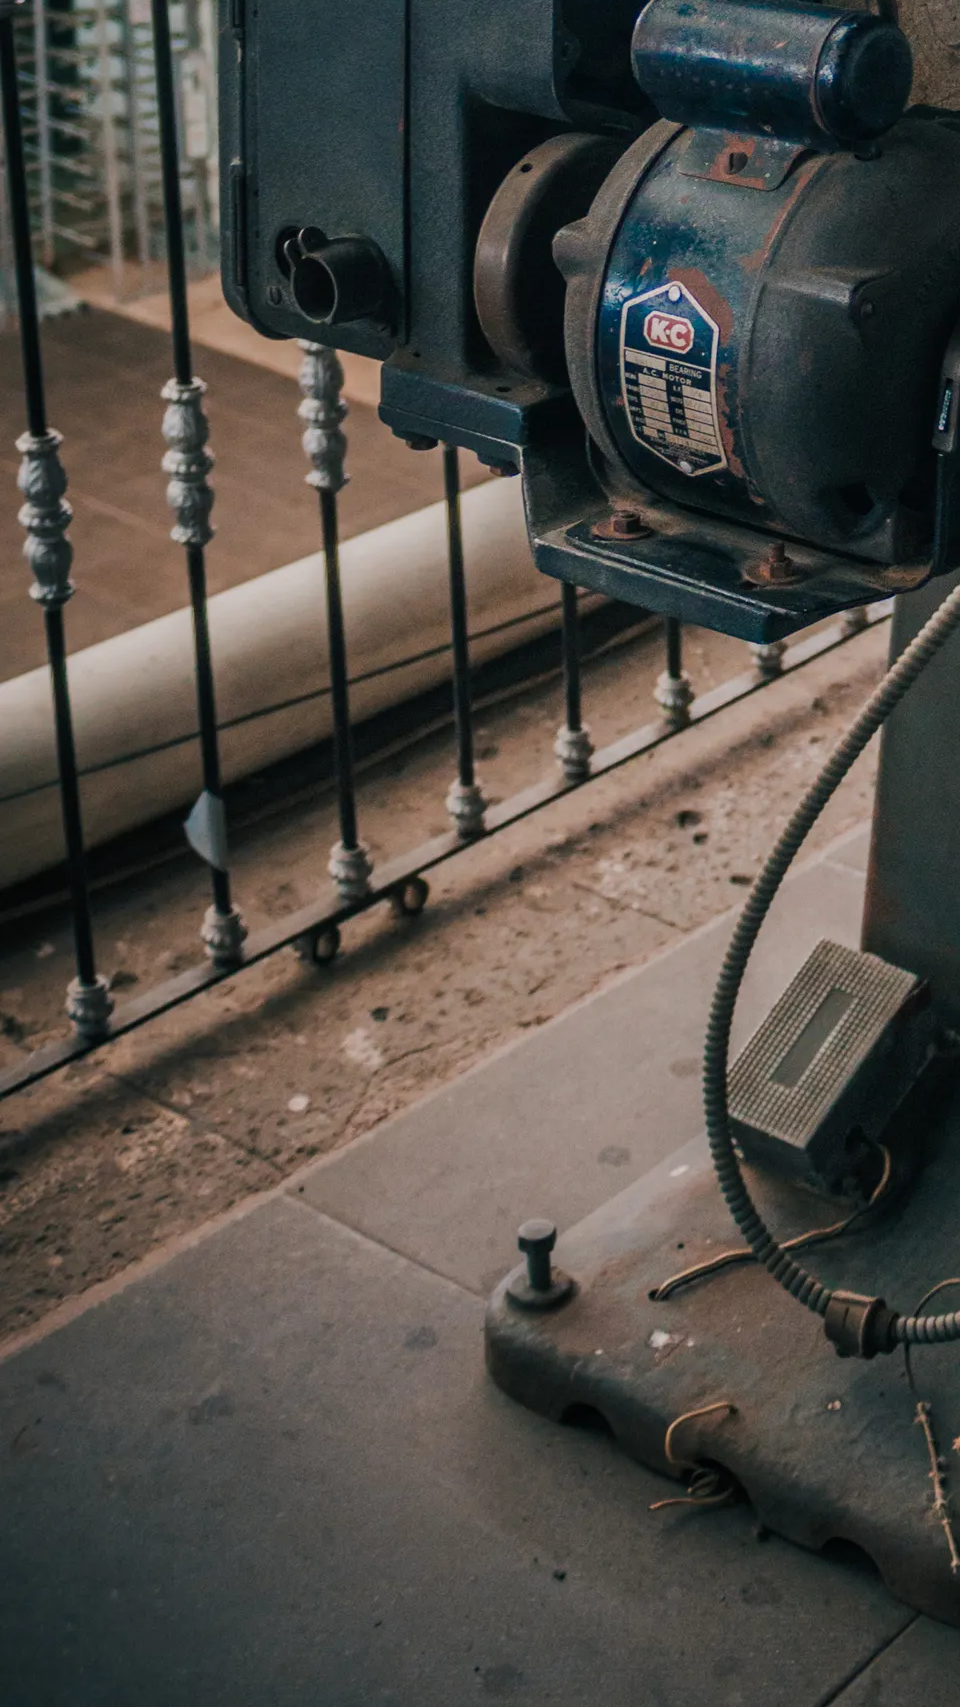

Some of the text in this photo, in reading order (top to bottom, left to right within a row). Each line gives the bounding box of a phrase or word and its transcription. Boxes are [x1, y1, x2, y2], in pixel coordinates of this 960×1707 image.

[642, 367, 692, 386] A.C. MOTOR
[669, 363, 703, 379] BEARING
